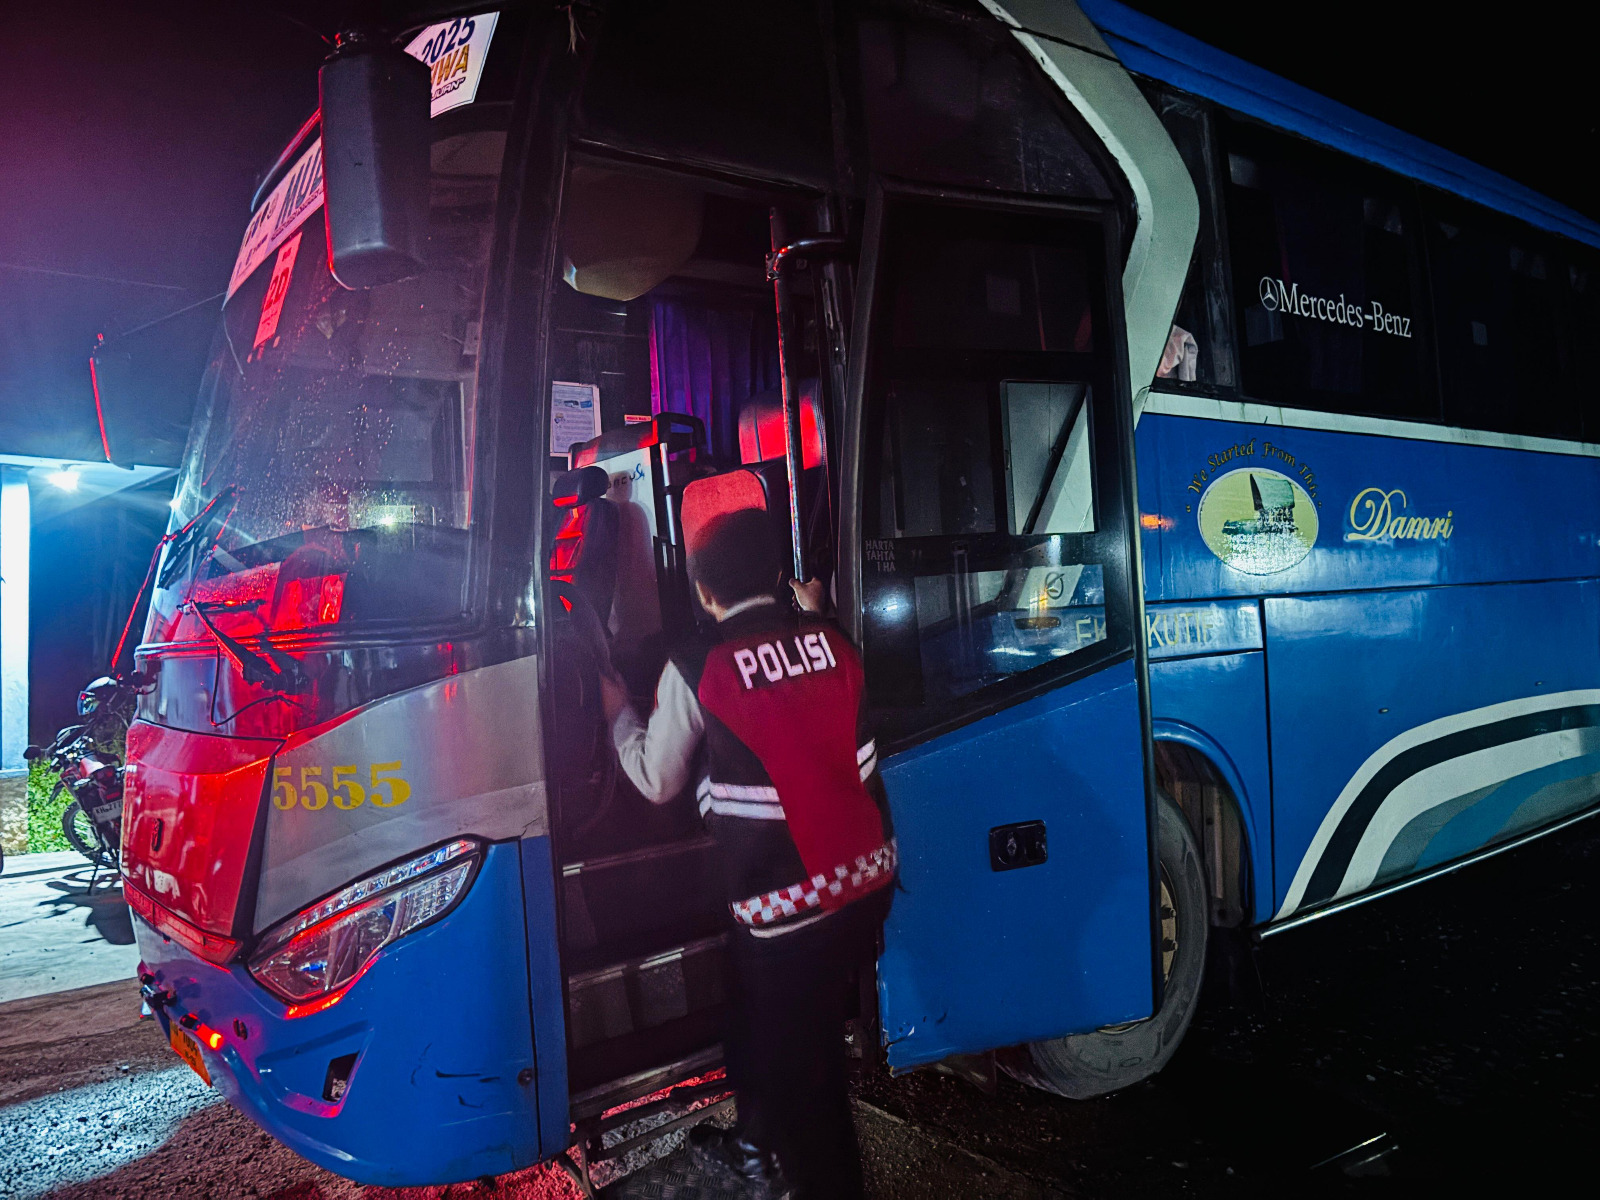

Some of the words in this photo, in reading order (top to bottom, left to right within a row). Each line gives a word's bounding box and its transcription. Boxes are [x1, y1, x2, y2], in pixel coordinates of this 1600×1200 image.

[421, 18, 476, 63] 2025
[1276, 279, 1412, 338] Mercedes-Benz
[1208, 438, 1256, 472] Started
[1262, 442, 1296, 468] From
[1347, 487, 1454, 540] Damri
[865, 539, 894, 551] HARTA
[734, 631, 837, 690] POLISI
[273, 760, 411, 811] 5555
